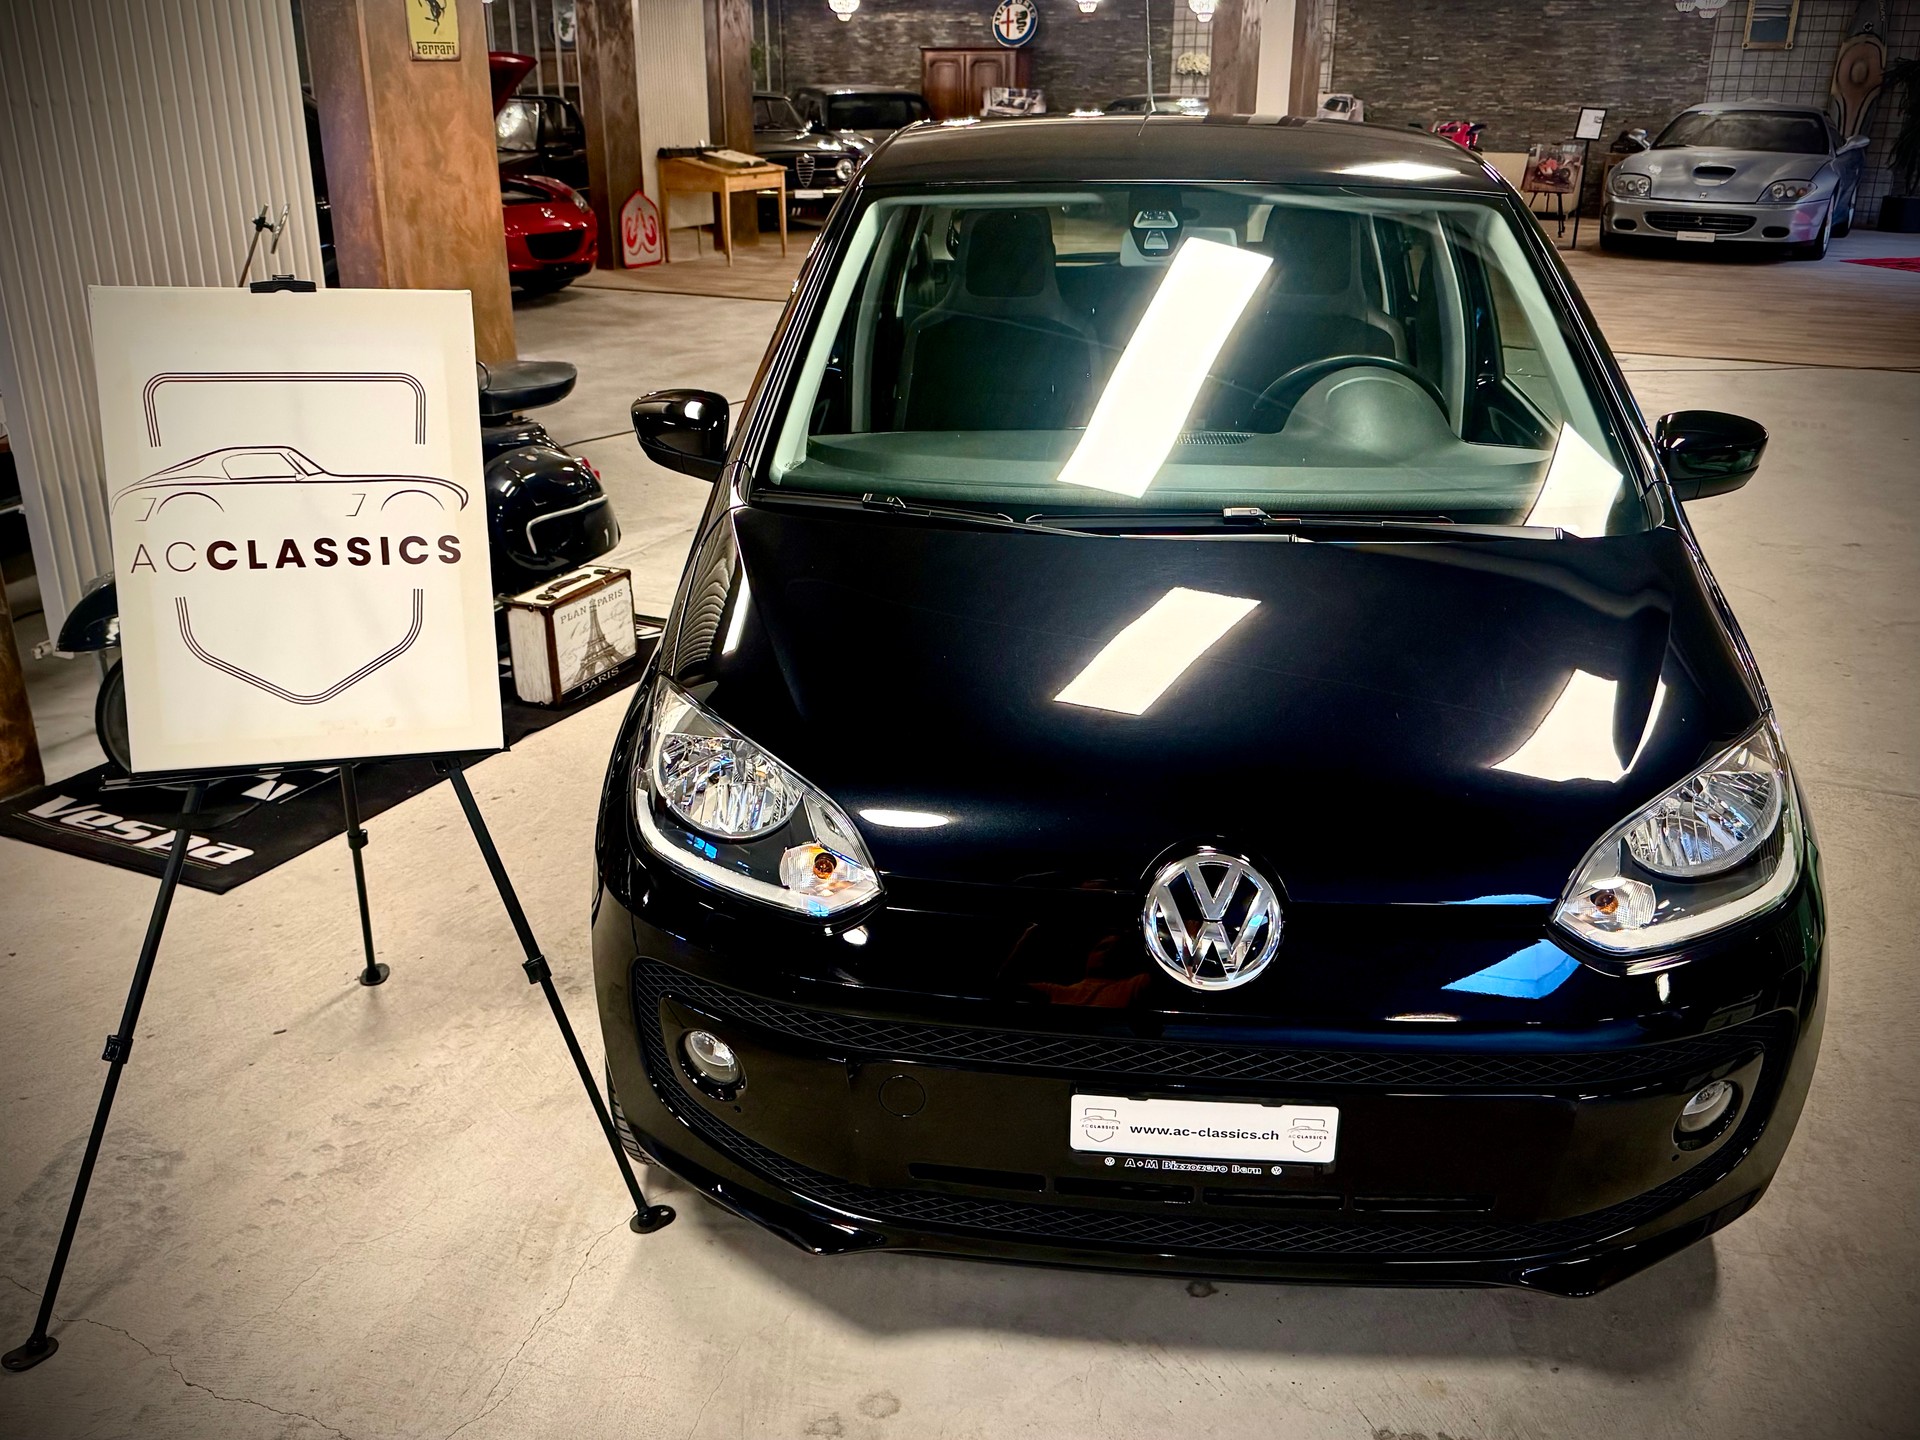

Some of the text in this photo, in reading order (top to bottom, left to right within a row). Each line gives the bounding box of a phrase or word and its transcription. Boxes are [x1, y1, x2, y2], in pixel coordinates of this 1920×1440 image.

[416, 41, 456, 55] Ferrari
[560, 589, 623, 624] PLAN PARIS
[581, 667, 620, 692] PARIS
[1130, 1125, 1279, 1141] www.ac-classics.ch
[1162, 1160, 1228, 1173] Bizzozero
